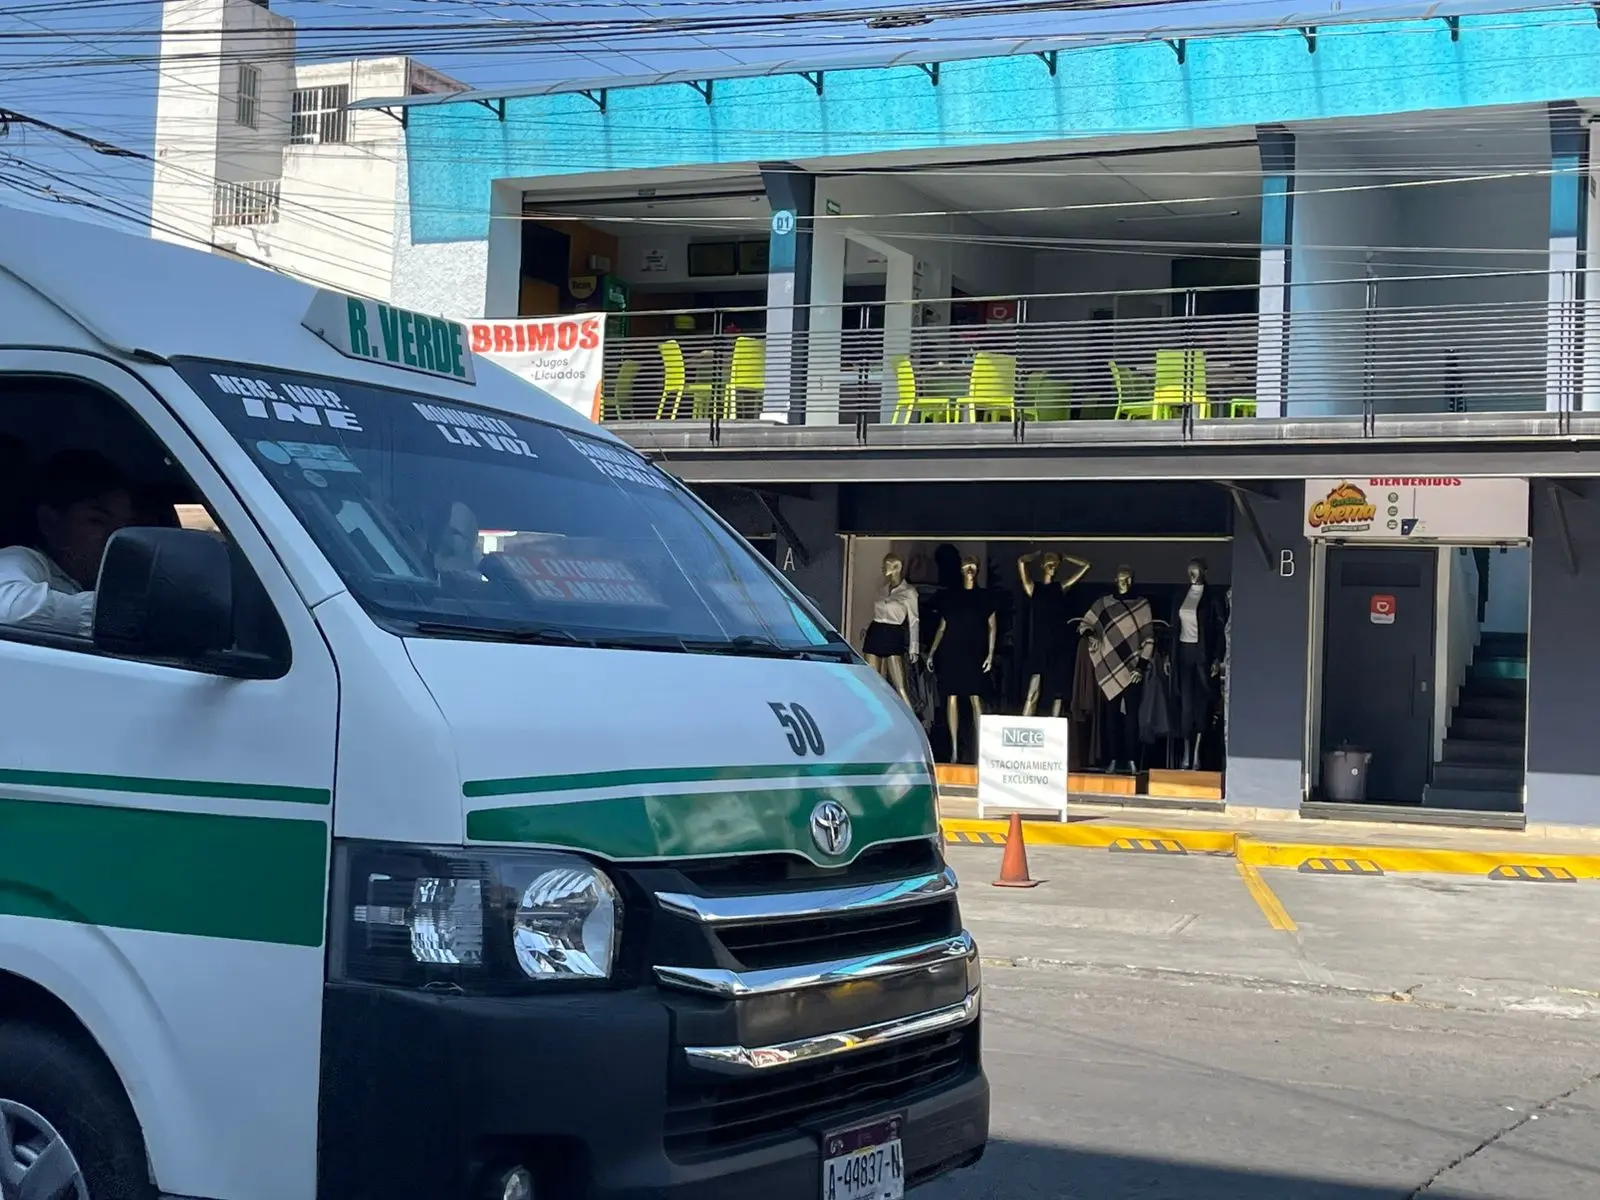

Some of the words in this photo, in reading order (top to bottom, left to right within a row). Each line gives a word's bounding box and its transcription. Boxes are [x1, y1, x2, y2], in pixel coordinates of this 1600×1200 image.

[347, 297, 379, 358] R.
[378, 304, 465, 378] VERDE
[209, 373, 285, 400] MERC.
[280, 383, 350, 410] INDEP.
[242, 397, 363, 432] INE
[411, 402, 518, 438] MONUMENTO
[436, 424, 482, 448] LA
[477, 431, 539, 458] VOZ
[783, 547, 795, 571] A
[1280, 549, 1295, 577] B
[766, 701, 825, 757] 50
[1002, 774, 1049, 785] EXCLUSIVO
